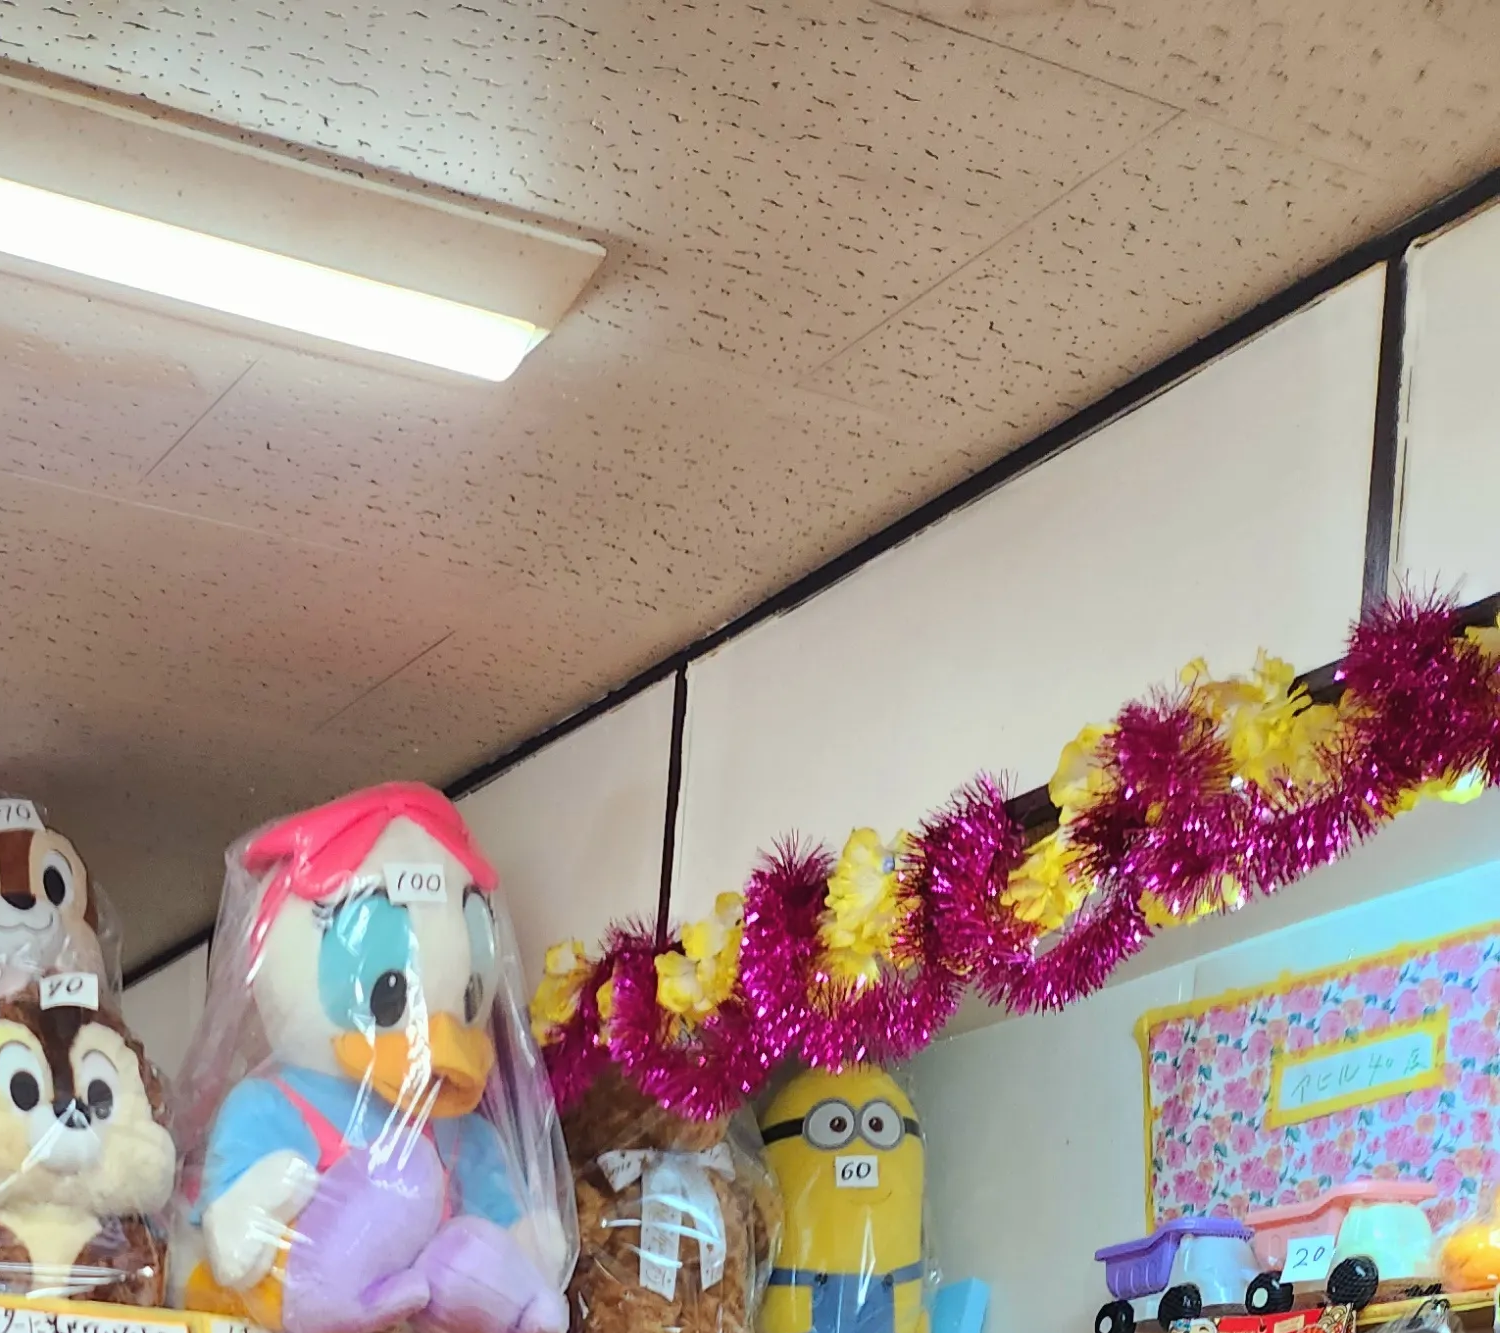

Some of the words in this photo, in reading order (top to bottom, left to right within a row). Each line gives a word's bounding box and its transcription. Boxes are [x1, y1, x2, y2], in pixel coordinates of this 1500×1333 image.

[395, 871, 441, 895] 100
[840, 1160, 872, 1181] 60
[1292, 1246, 1325, 1269] 20
